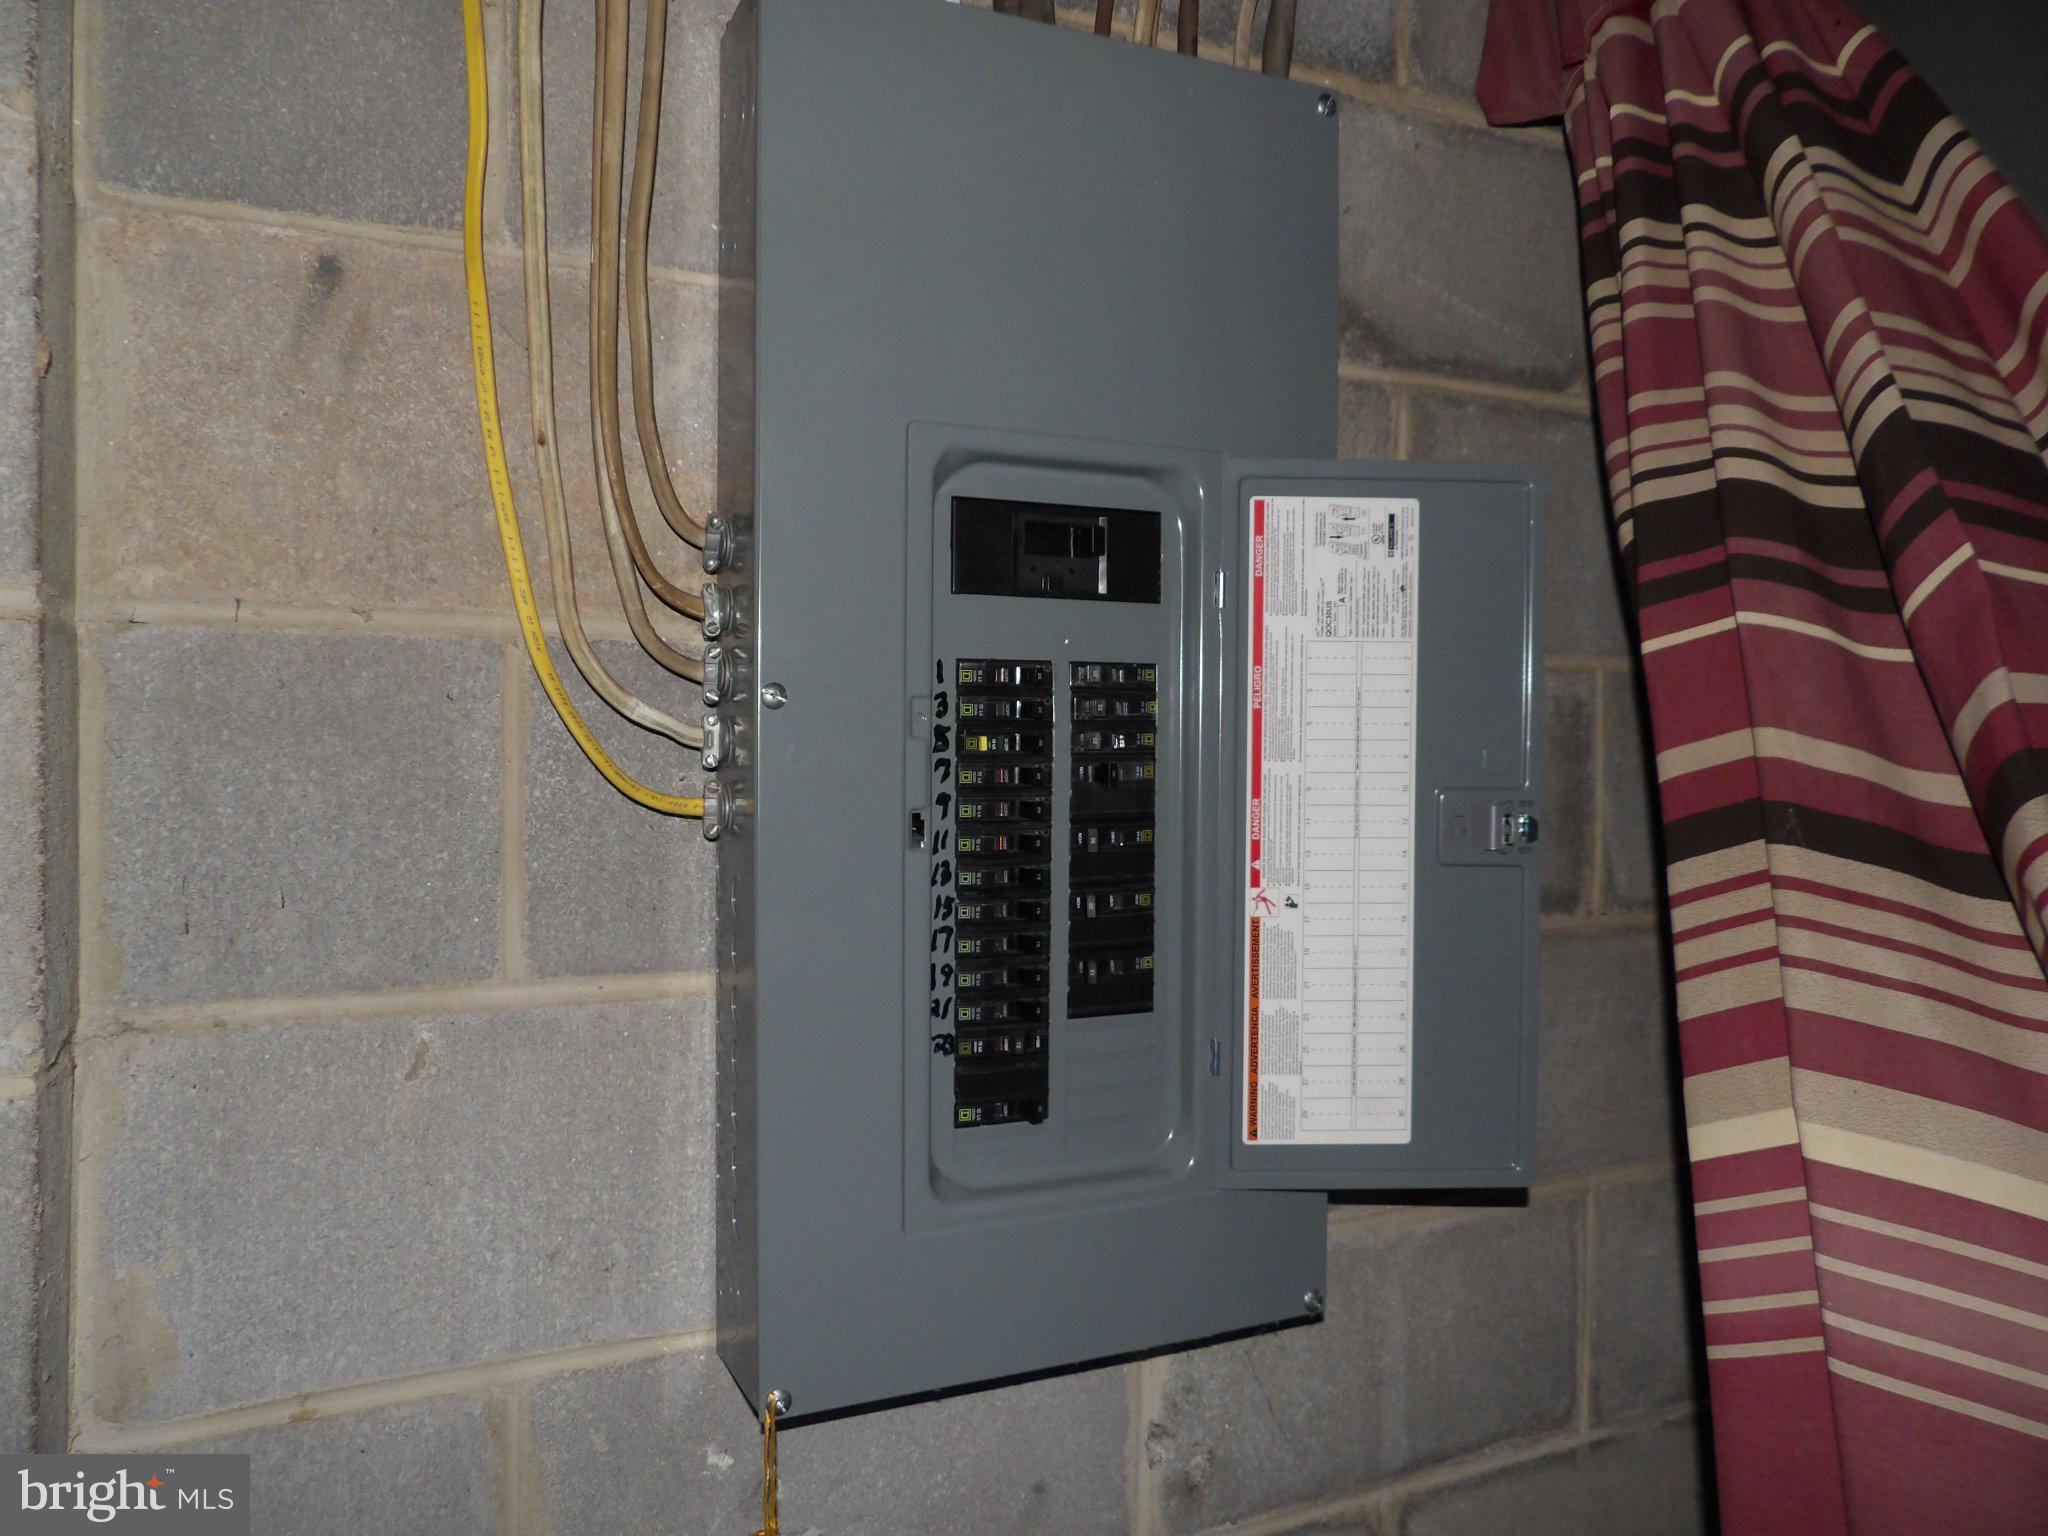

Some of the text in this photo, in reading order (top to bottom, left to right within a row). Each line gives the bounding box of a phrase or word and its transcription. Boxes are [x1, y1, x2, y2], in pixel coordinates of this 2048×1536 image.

[1254, 534, 1264, 577] DANGER
[936, 658, 944, 684] 1
[1253, 665, 1262, 710] PELIGRO
[933, 691, 948, 719] 3
[934, 757, 951, 783] 7
[1251, 798, 1260, 840] DANGER
[932, 829, 949, 855] 11
[931, 859, 951, 887] 13
[934, 894, 955, 921] 15
[931, 926, 954, 953] 17
[1251, 919, 1260, 999] AVERTISSEMENT
[930, 963, 953, 991] 19
[1250, 1006, 1259, 1074] ADVERTENCIA
[1249, 1081, 1258, 1126] WARNING
